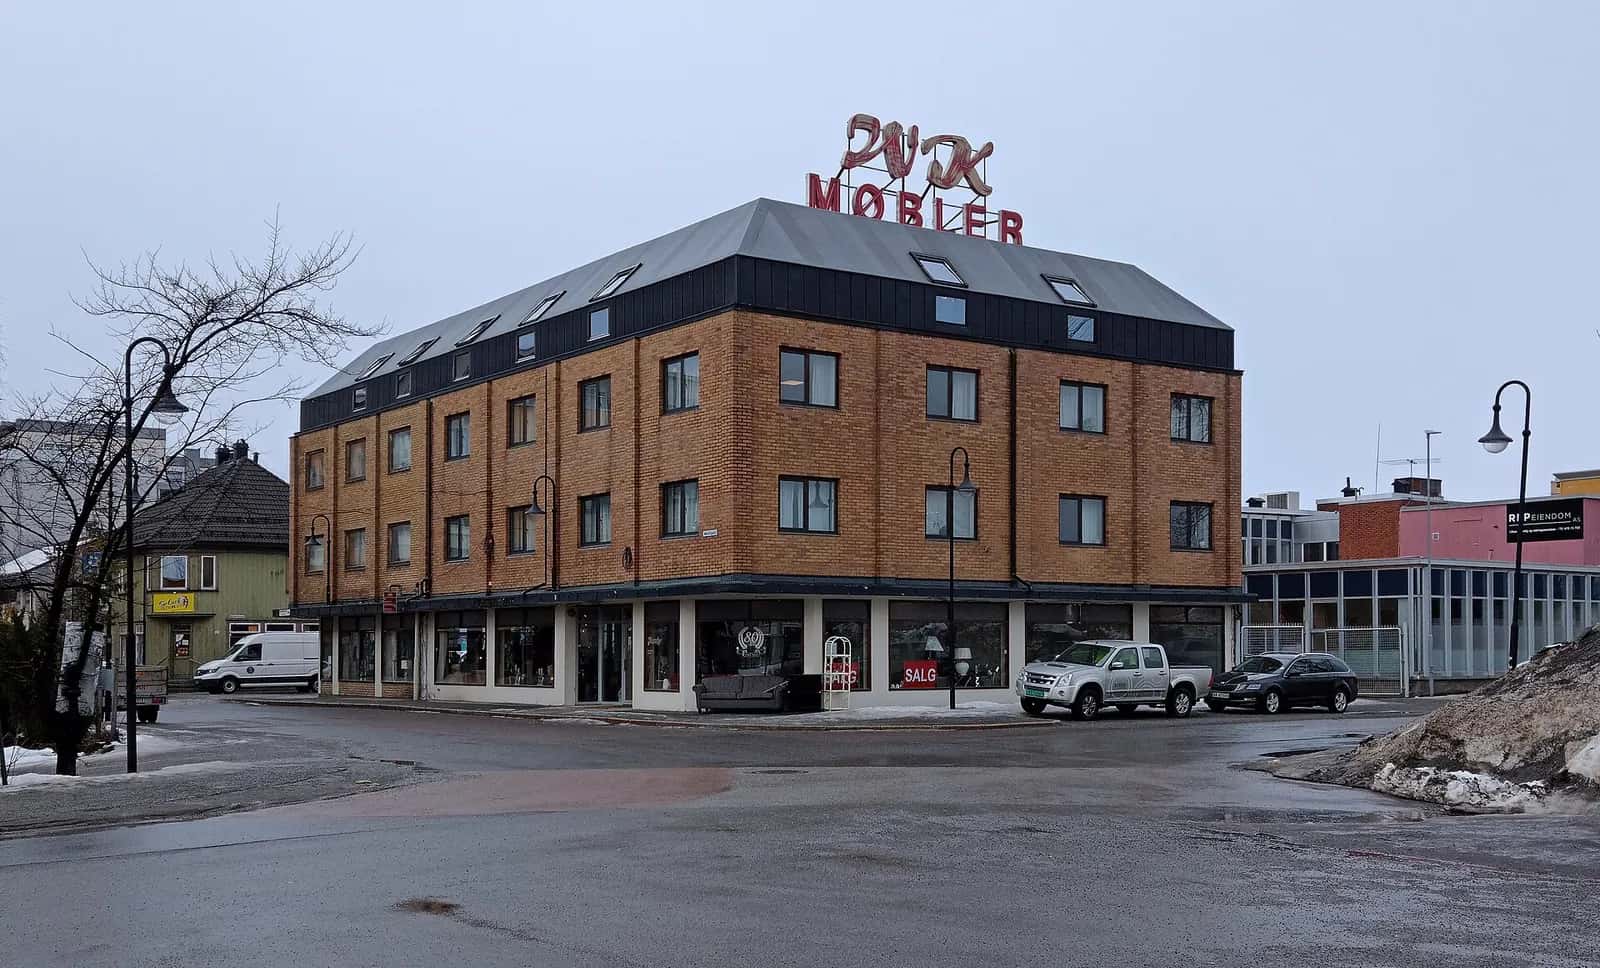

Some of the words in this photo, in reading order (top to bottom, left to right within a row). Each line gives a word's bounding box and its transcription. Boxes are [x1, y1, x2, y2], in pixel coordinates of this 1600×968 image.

[806, 172, 1024, 246] MØBLER
[743, 631, 759, 643] 80
[905, 668, 936, 682] SALG
